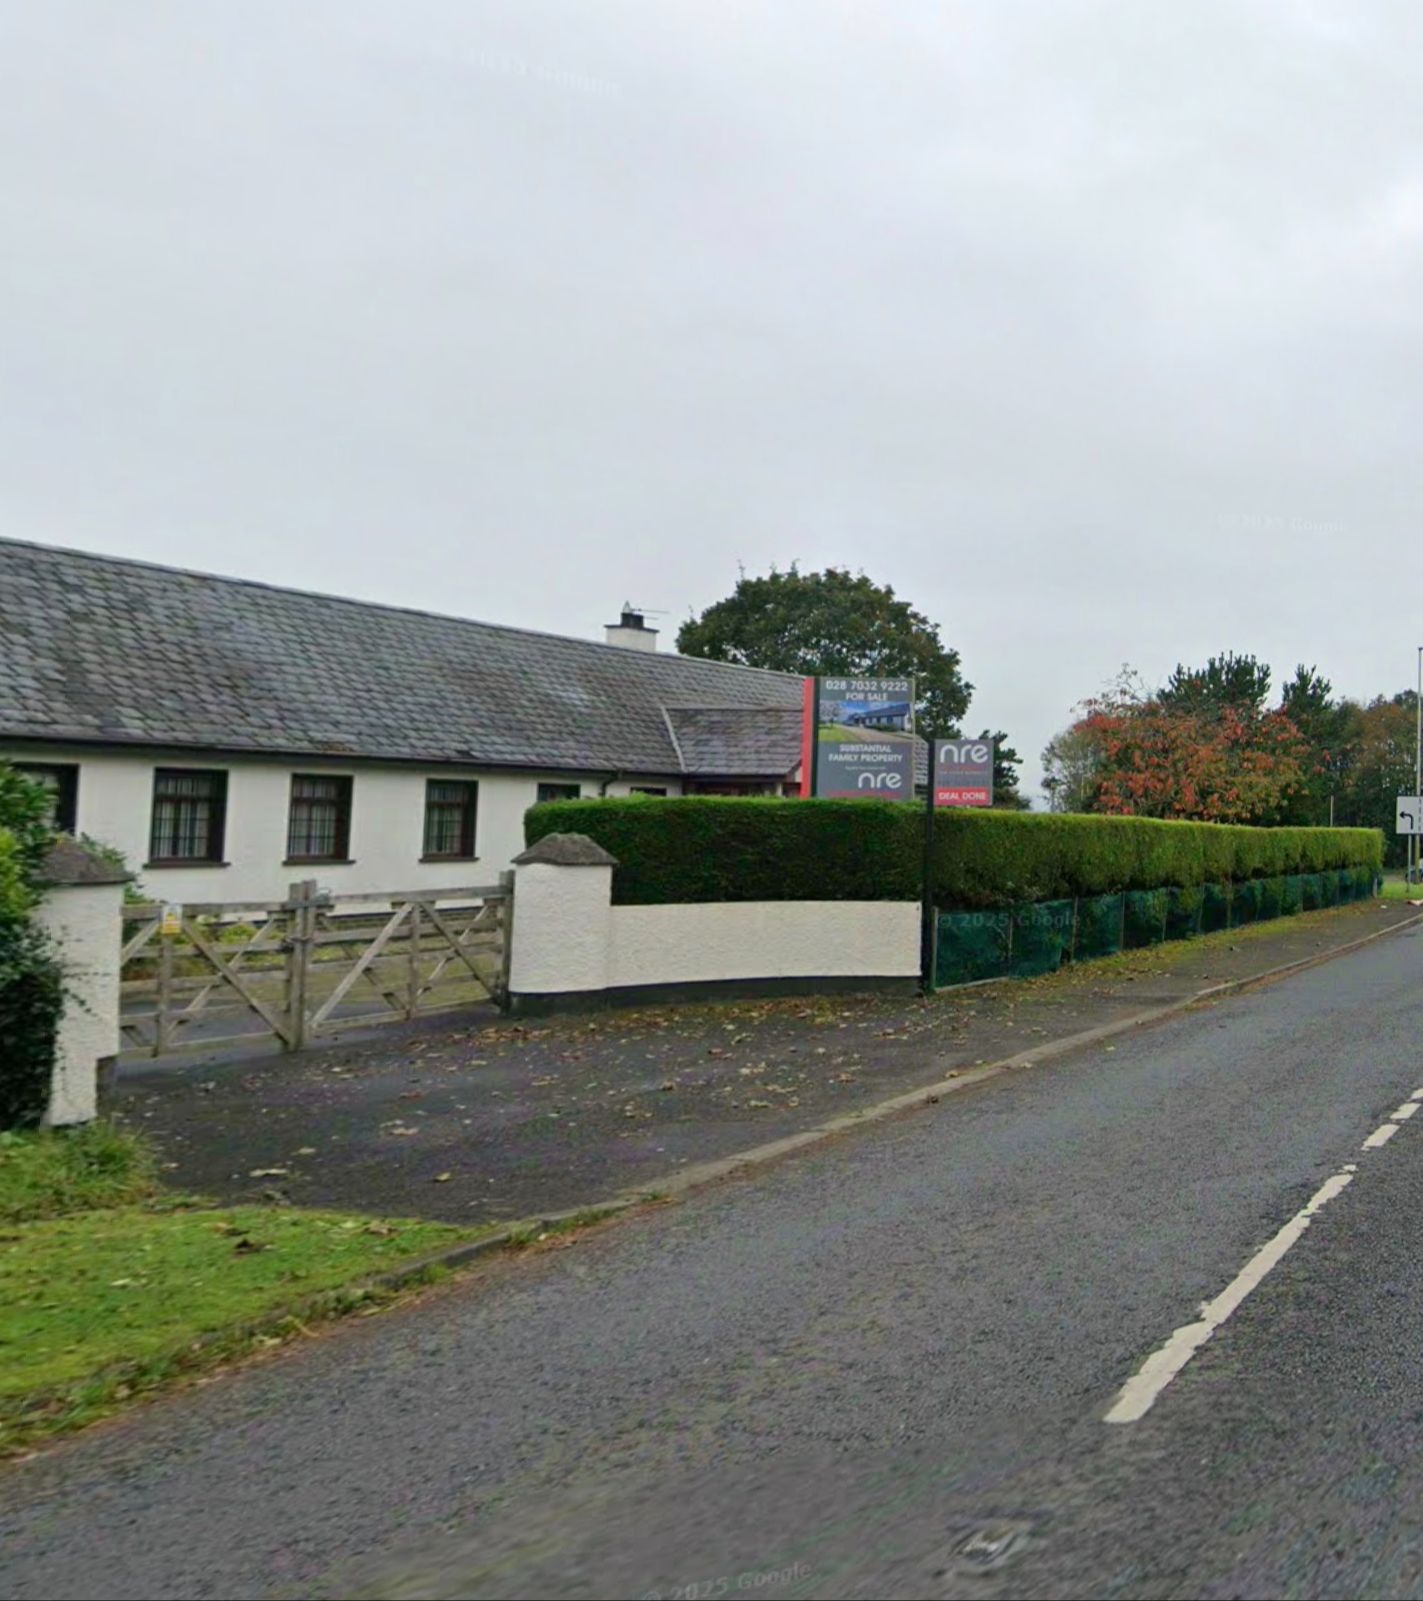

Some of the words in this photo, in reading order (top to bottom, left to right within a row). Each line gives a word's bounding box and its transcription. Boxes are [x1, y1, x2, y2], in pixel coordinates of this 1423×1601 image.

[826, 680, 847, 690] 028
[850, 681, 878, 691] 7032
[880, 681, 908, 691] 9222
[845, 692, 865, 701] FOR
[867, 692, 889, 701] SALE
[828, 753, 860, 762] FAMILY
[861, 753, 903, 762] PROPERTY
[940, 744, 989, 763] nre
[858, 772, 902, 788] nre
[938, 791, 960, 800] DEAL
[962, 791, 987, 800] DONE
